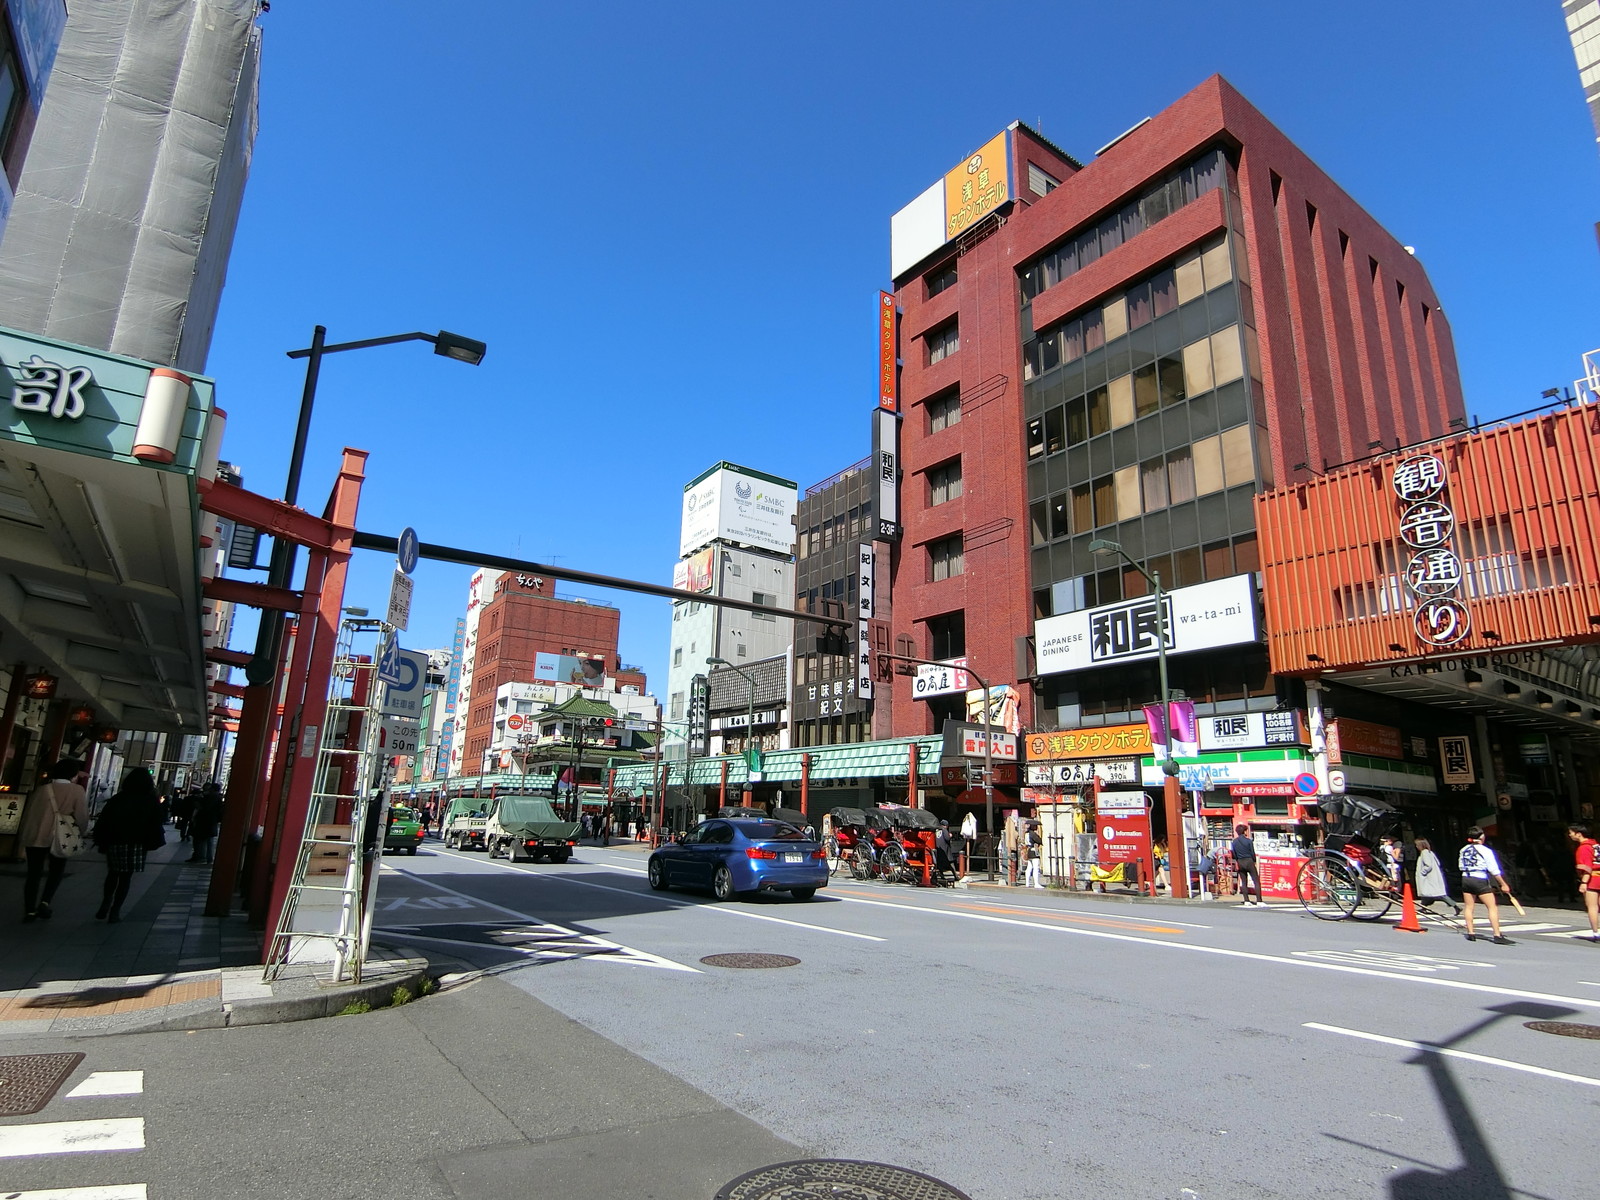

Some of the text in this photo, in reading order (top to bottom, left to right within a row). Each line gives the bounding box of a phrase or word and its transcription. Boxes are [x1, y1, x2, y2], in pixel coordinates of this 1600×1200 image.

[962, 168, 990, 203] 浅草
[949, 181, 1005, 235] タウンホテル
[883, 308, 892, 394] 浅草タウンホテル
[12, 355, 92, 419] 部
[882, 396, 893, 406] 5F
[882, 453, 894, 481] 和民
[764, 496, 784, 507] SMBC
[1395, 459, 1457, 640] 観音通り
[516, 573, 543, 589] ちんや
[1180, 603, 1242, 624] wa-ta-mi
[1092, 602, 1169, 657] 和民
[1043, 634, 1083, 647] JAPANESE
[1043, 645, 1070, 656] DINING
[391, 698, 416, 711] 駐車場
[820, 698, 843, 715] 紀文
[393, 726, 418, 737] この先
[1215, 717, 1247, 735] 和民
[392, 740, 415, 751] 50m
[965, 739, 1014, 756] 雷門入口
[1445, 741, 1467, 772] 和民
